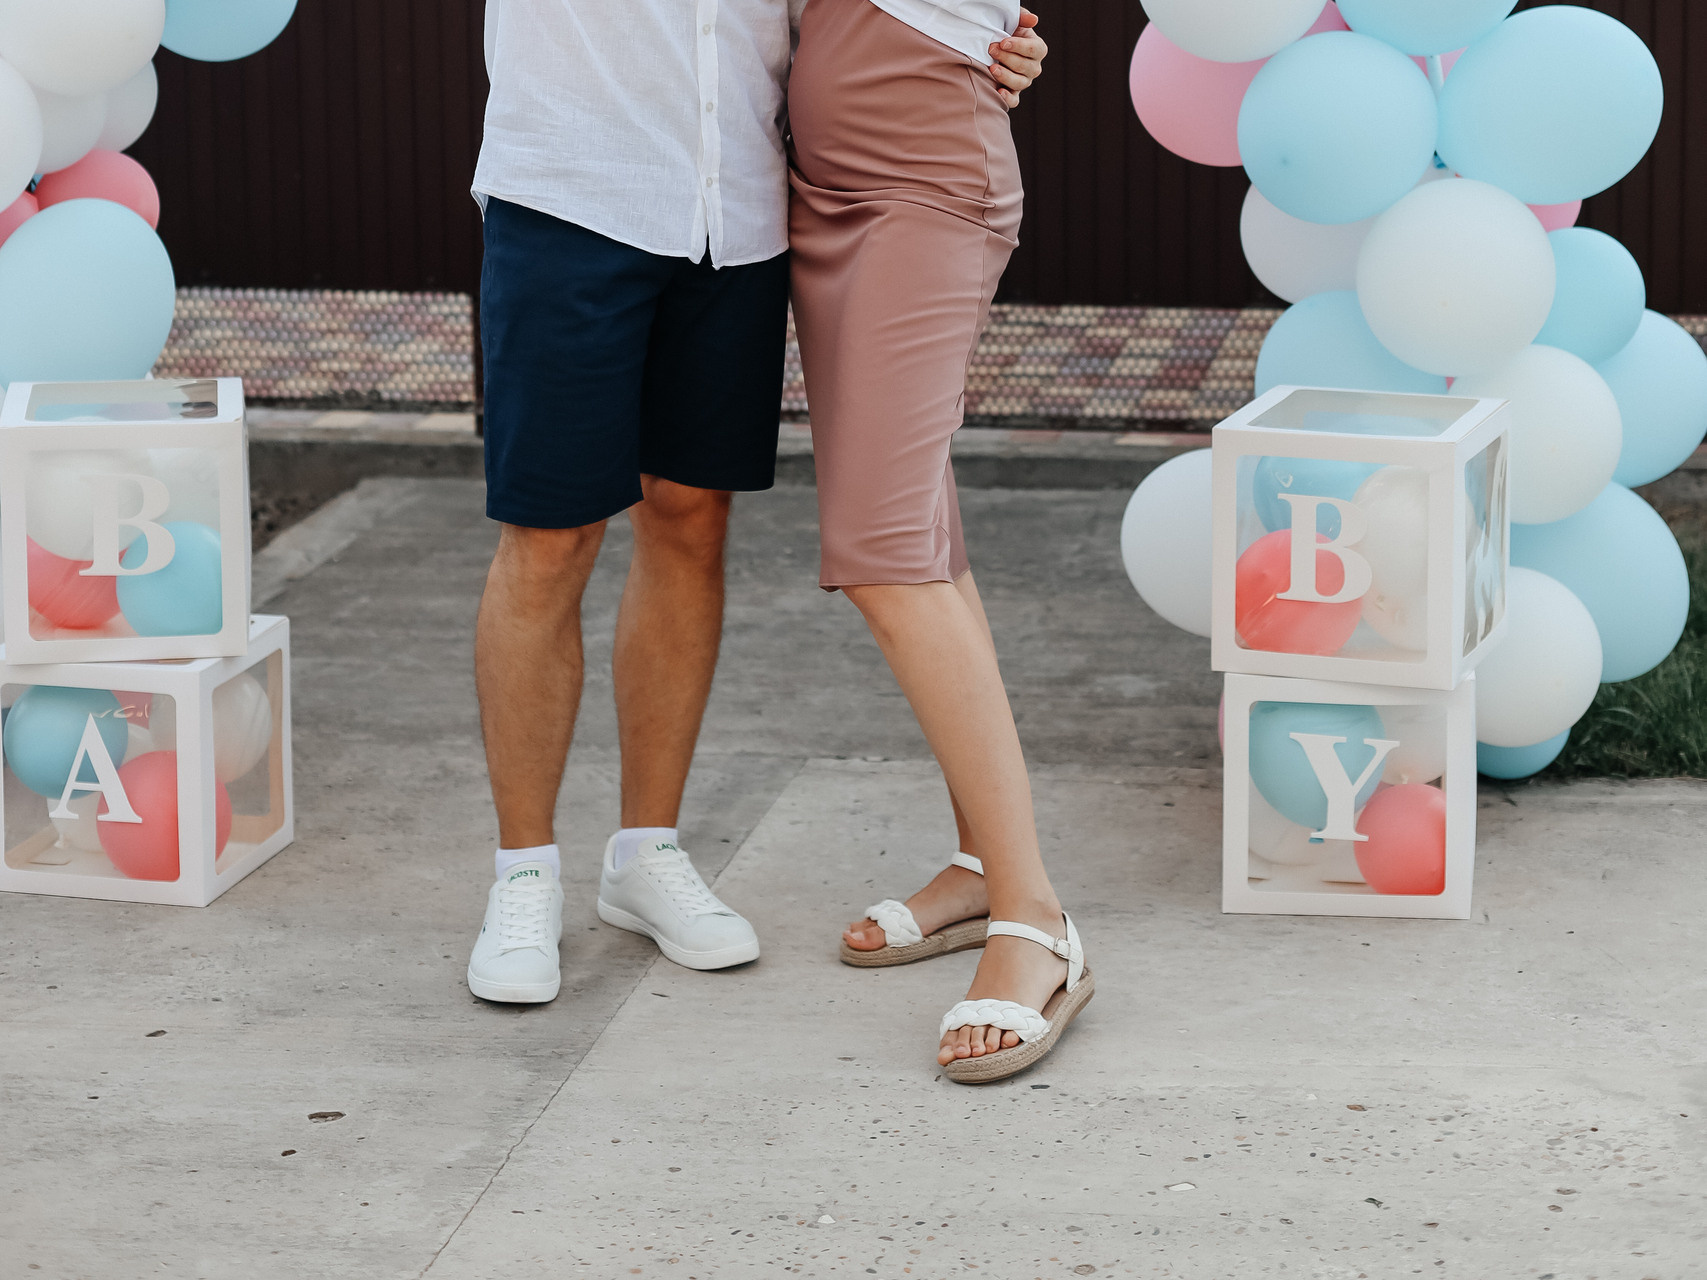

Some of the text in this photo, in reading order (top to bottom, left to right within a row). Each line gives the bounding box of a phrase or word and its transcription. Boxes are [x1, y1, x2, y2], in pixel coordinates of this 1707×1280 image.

[79, 474, 175, 576] B
[1276, 493, 1372, 603] B
[49, 713, 142, 824] A
[1289, 732, 1400, 843] Y
